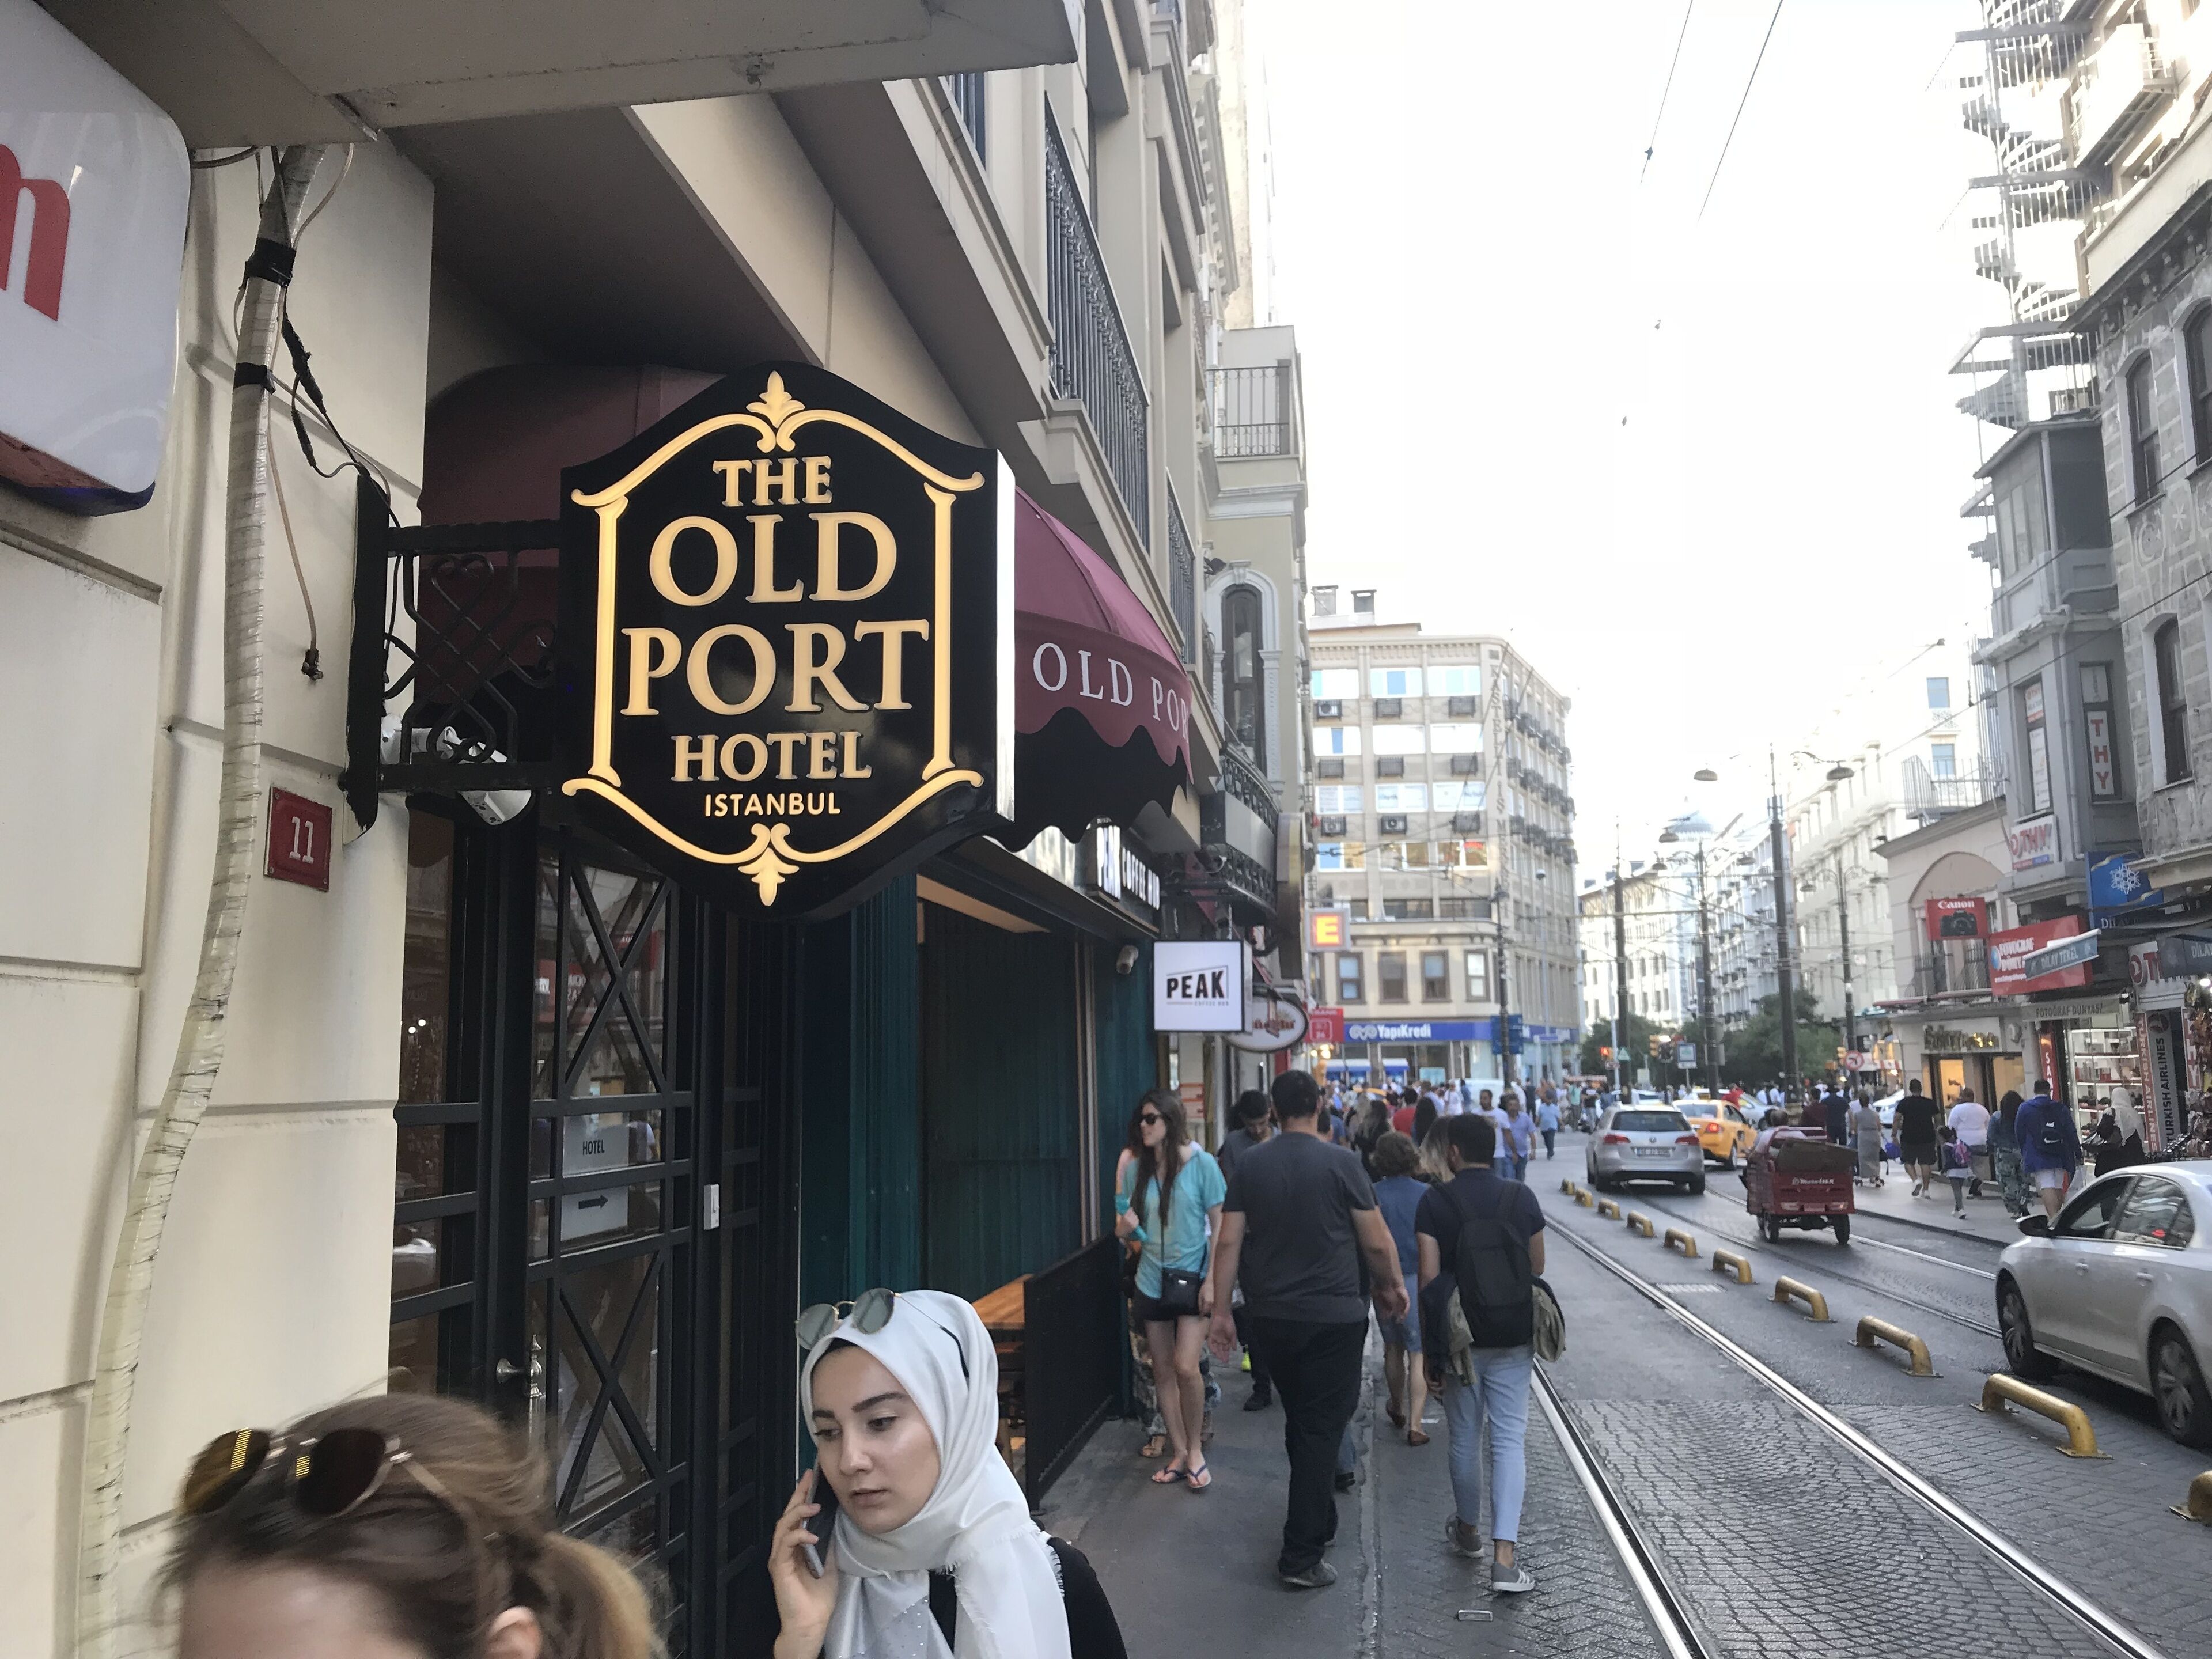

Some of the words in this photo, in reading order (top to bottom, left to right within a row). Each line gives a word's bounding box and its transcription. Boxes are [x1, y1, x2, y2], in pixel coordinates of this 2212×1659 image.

[712, 456, 832, 507] THE
[649, 511, 898, 607] OLD
[620, 618, 929, 717] PORT
[1033, 642, 1133, 706] OLD
[671, 731, 872, 782] HOTEL
[2090, 719, 2109, 790] THY
[704, 791, 840, 818] ISTANBUL
[289, 816, 314, 864] 11
[1937, 900, 1975, 910] Canon
[1166, 971, 1225, 999] PEAK
[2137, 1017, 2150, 1082] TURKISH
[2145, 1084, 2158, 1152] AIRLINES
[2156, 1037, 2169, 1091] AIRLINES
[2162, 1092, 2175, 1142] TURKISH
[582, 1139, 605, 1156] HOTEL
